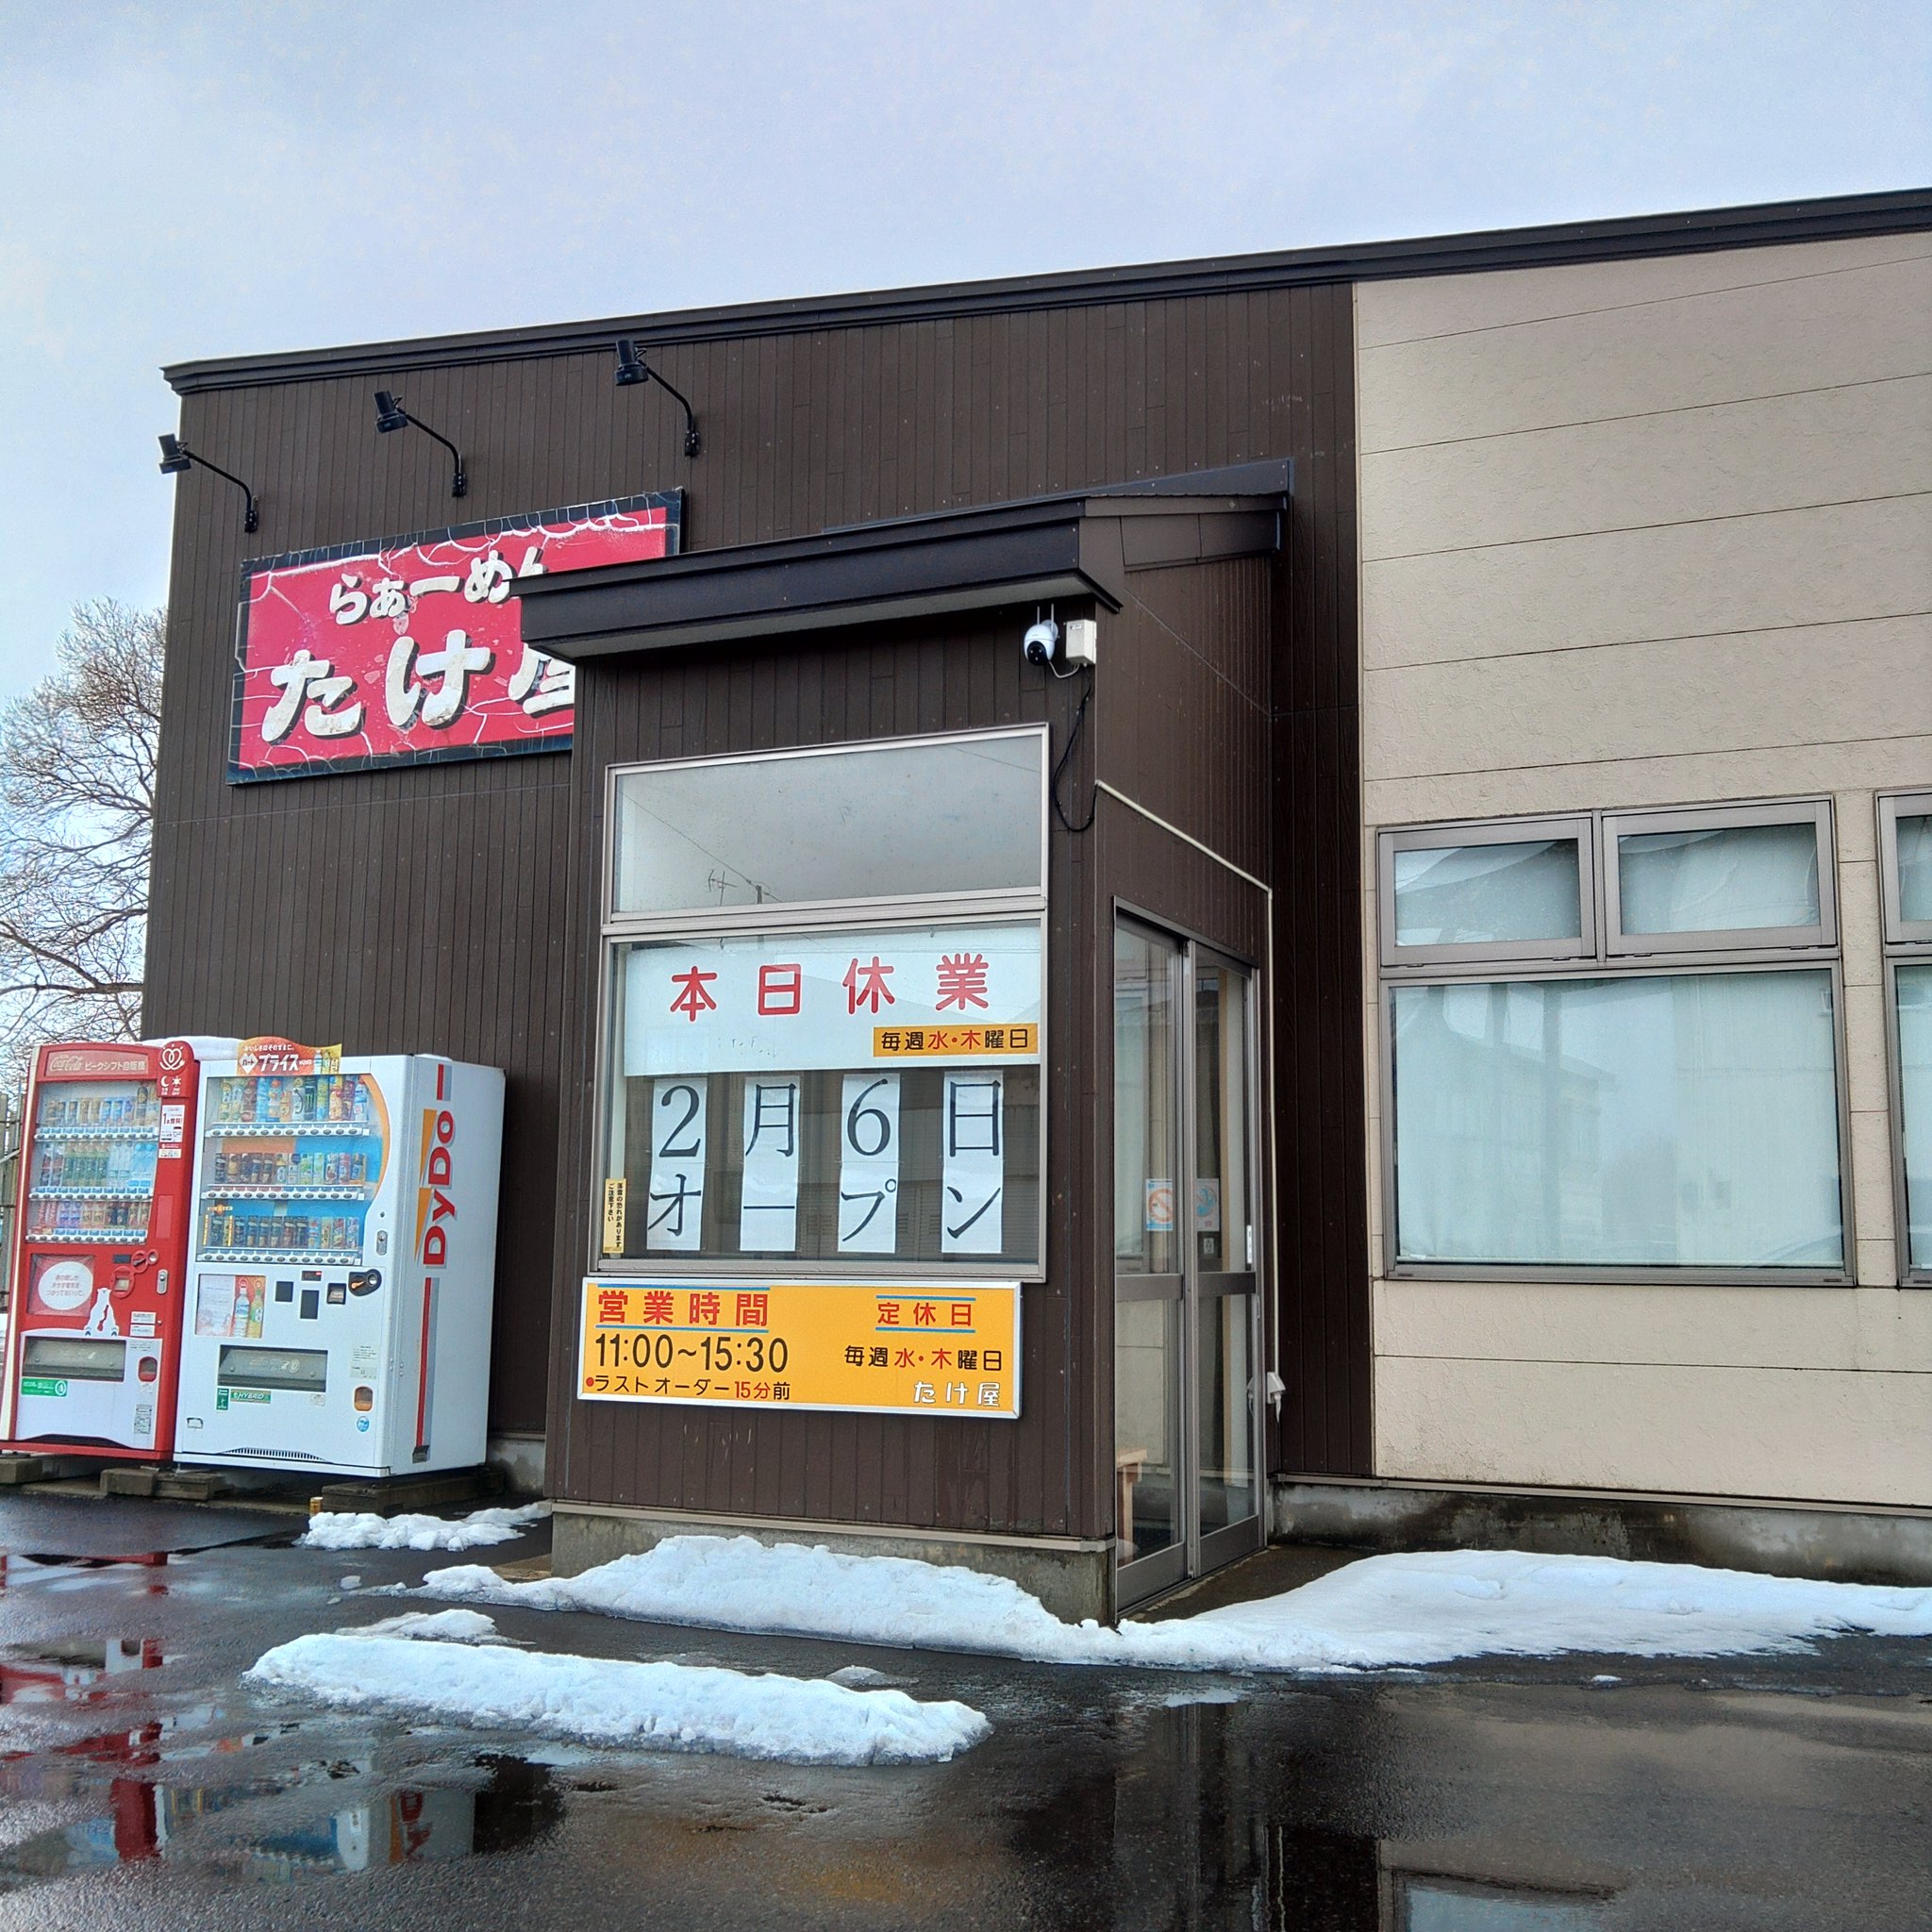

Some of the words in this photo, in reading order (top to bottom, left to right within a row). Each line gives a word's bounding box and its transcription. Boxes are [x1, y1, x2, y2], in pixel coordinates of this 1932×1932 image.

[670, 952, 990, 1023] 本日休業
[880, 1028, 1028, 1052] 毎週水・木曜日
[258, 1053, 299, 1072] プライス
[658, 1078, 1001, 1158] 2月6日
[648, 1174, 1001, 1242] オープン
[597, 1290, 769, 1326] 営業時間
[876, 1302, 973, 1326] 定休日
[844, 1345, 1003, 1373] 毎週水・木曜日
[913, 1380, 1001, 1407] たけ屋
